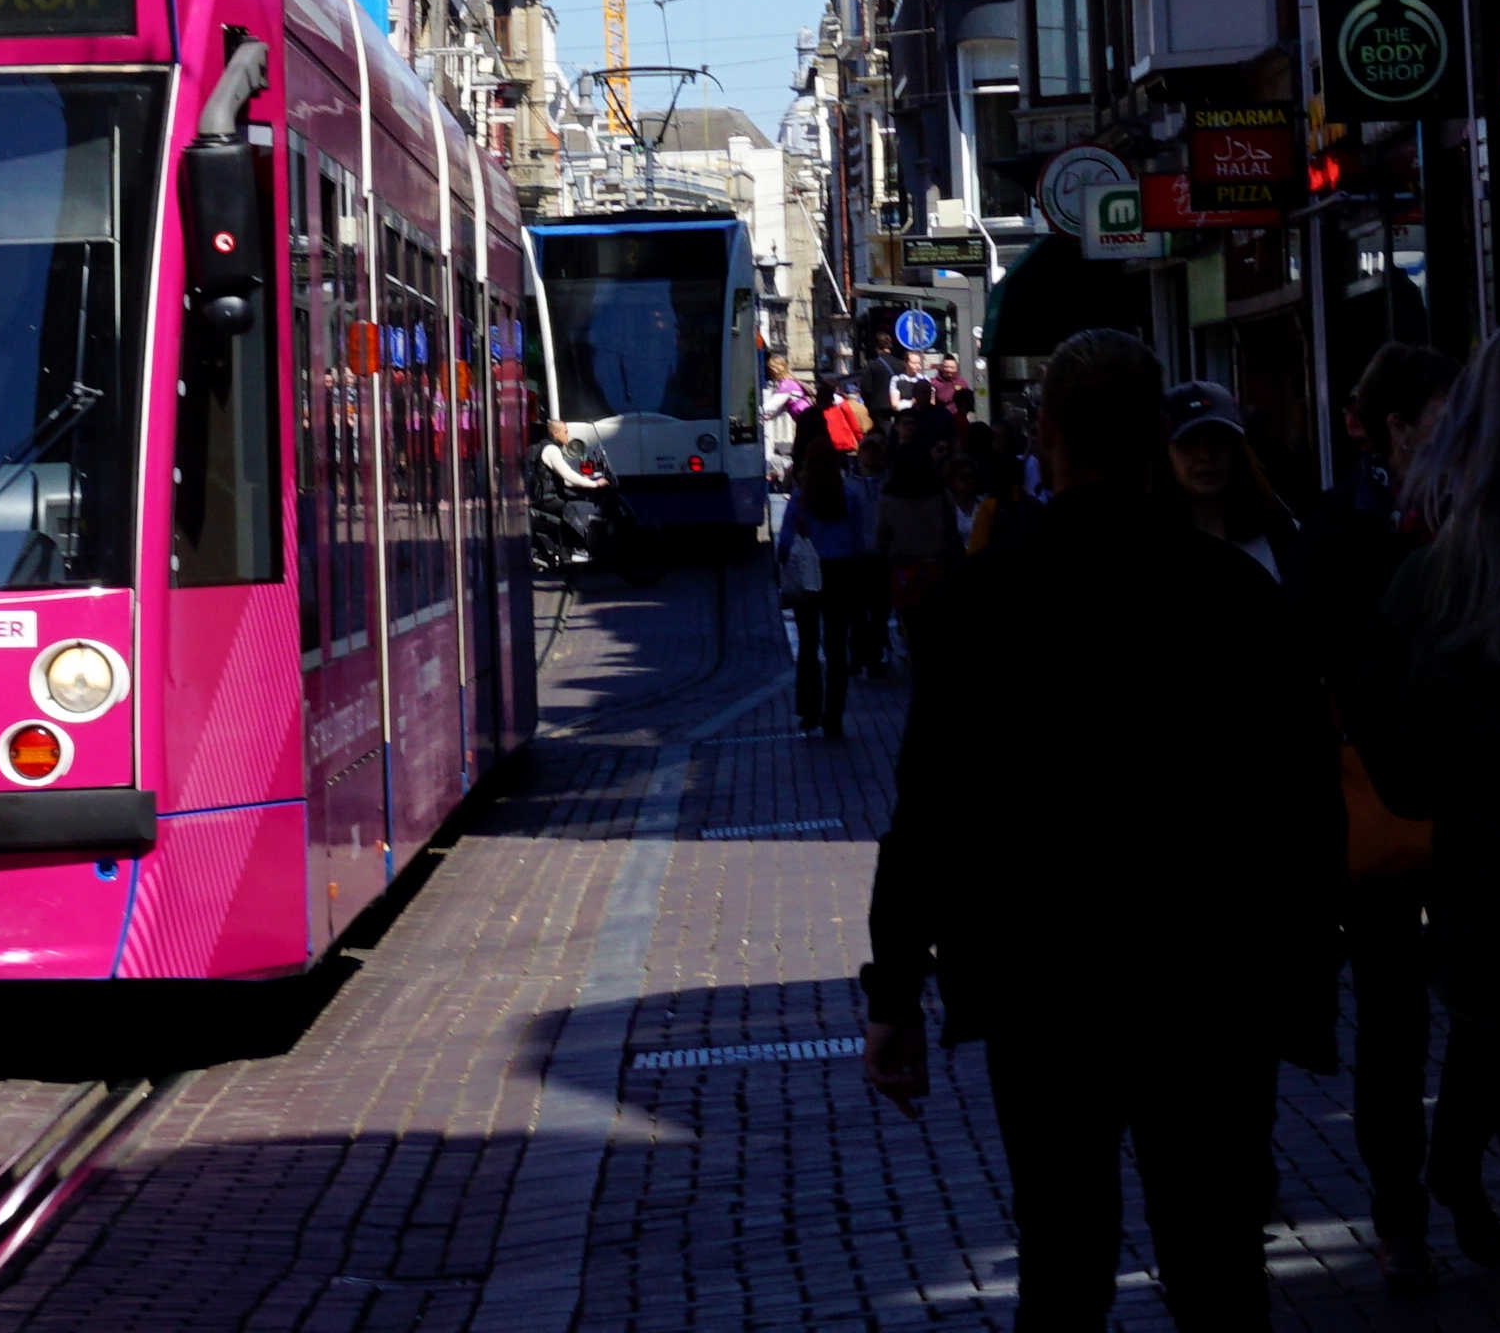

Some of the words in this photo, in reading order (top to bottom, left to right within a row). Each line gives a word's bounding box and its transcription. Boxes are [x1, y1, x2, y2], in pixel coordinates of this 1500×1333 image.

[1372, 27, 1413, 44] THE
[1360, 44, 1427, 64] BODY
[1366, 63, 1425, 83] SHOP
[1194, 108, 1288, 127] SHOARMA
[1215, 161, 1272, 175] HALAL
[1216, 185, 1273, 202] PIZZA
